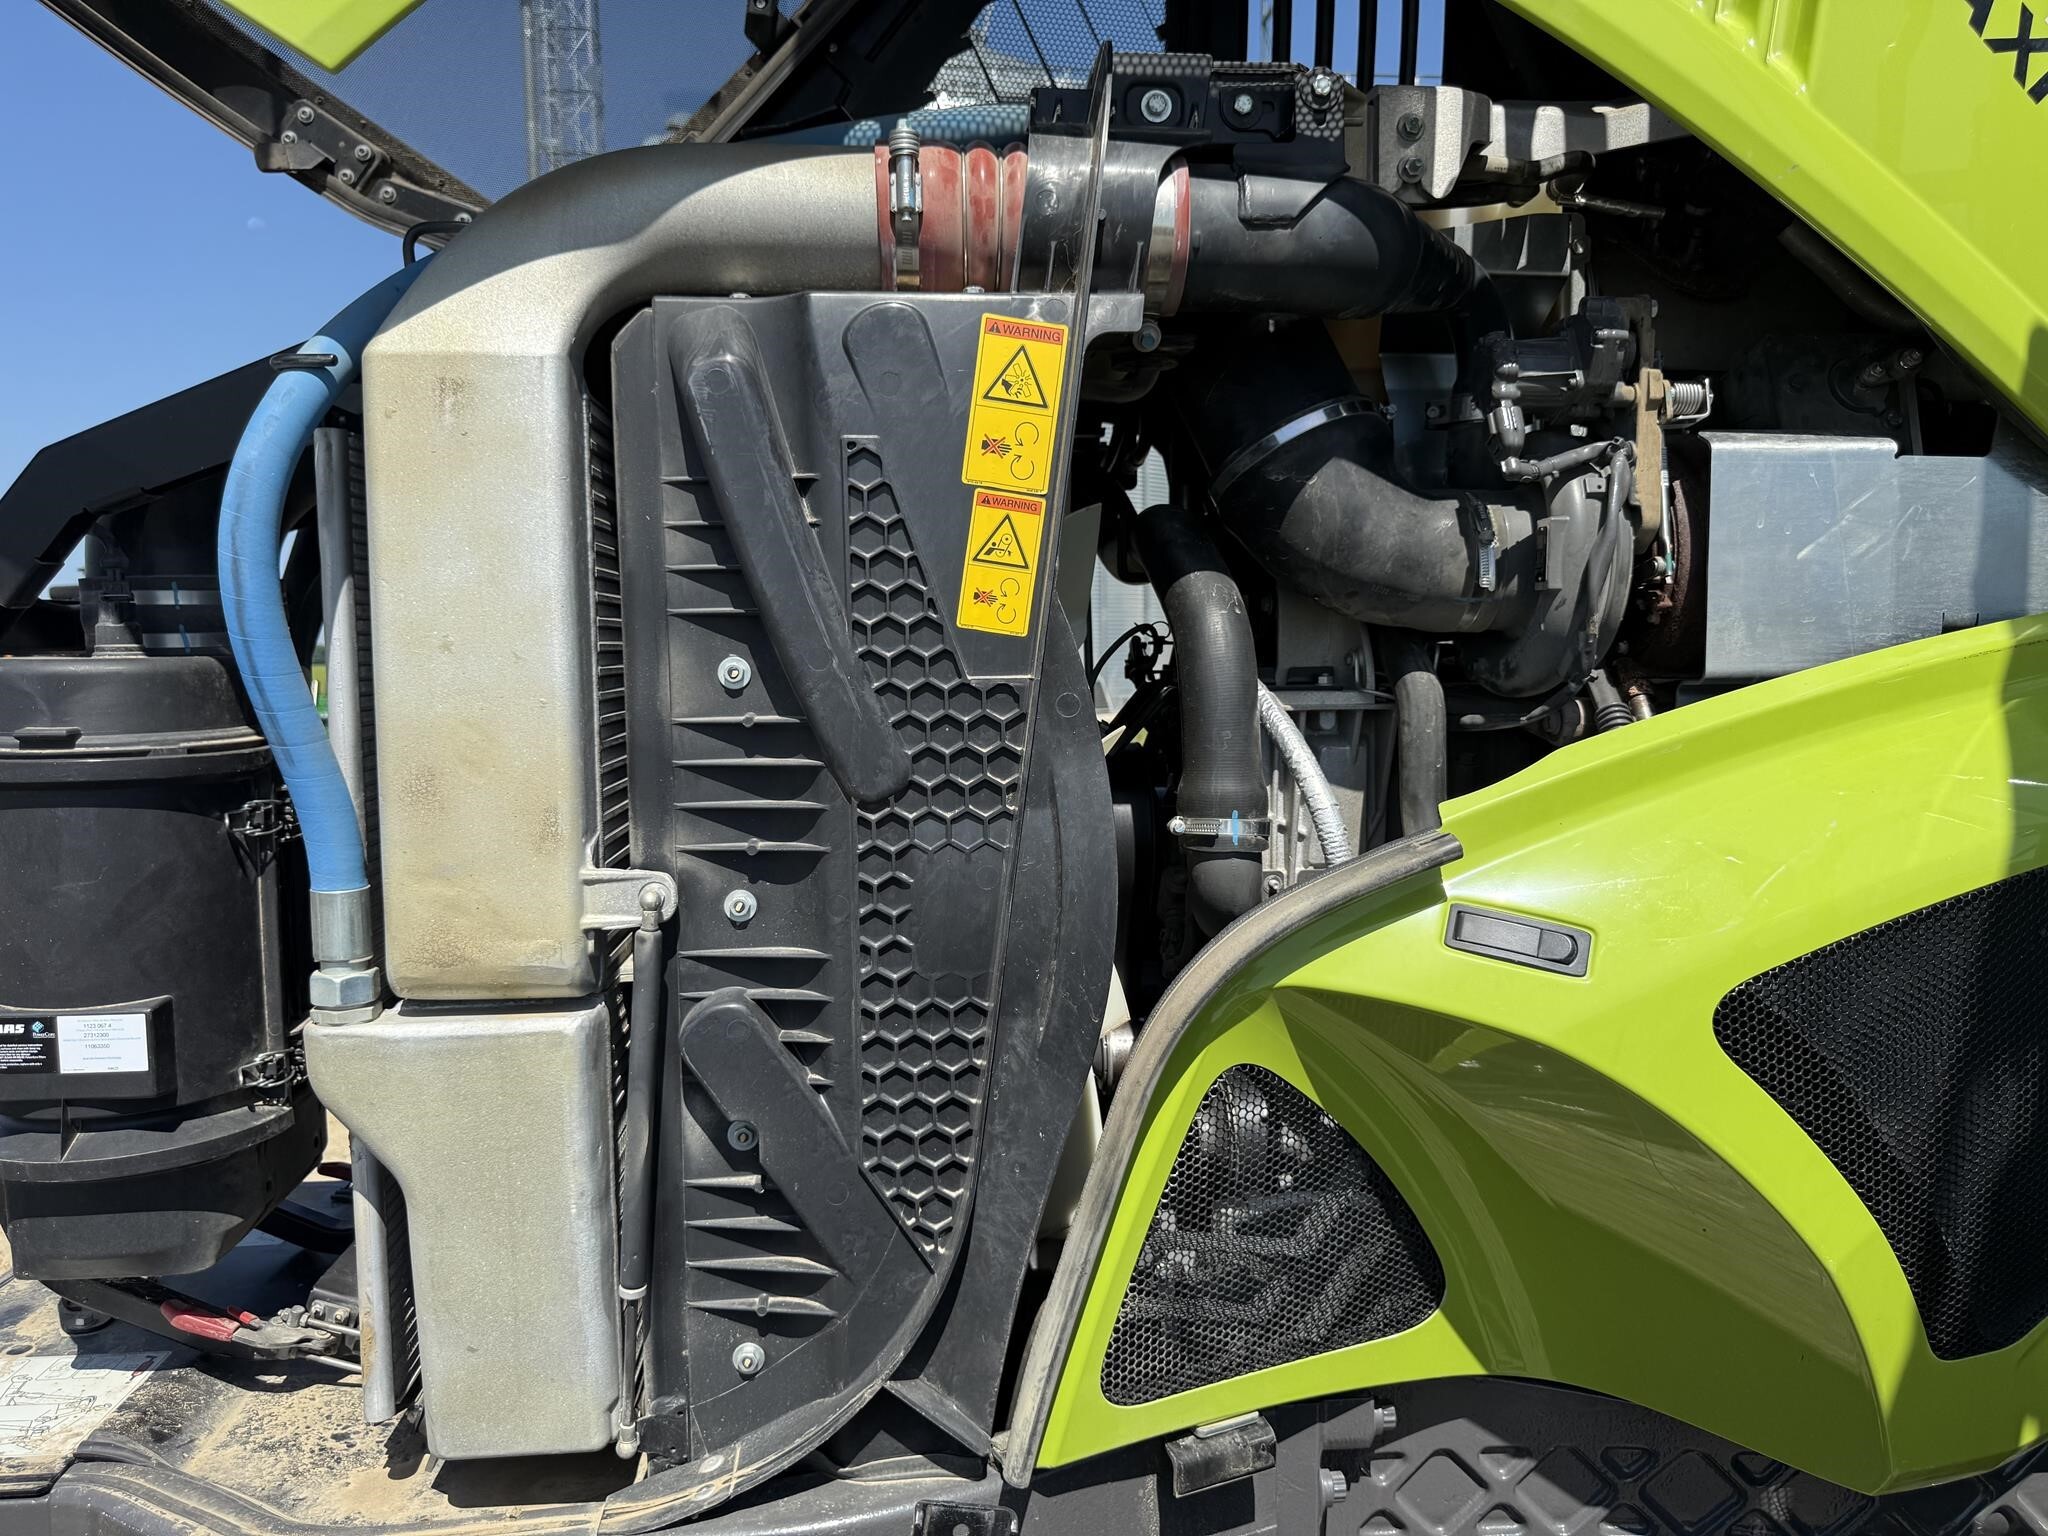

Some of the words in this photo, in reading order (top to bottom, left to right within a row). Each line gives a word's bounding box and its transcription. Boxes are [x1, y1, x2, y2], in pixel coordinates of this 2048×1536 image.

[1002, 323, 1061, 342] WARNING
[992, 497, 1038, 511] WARNING
[0, 1023, 25, 1034] AS
